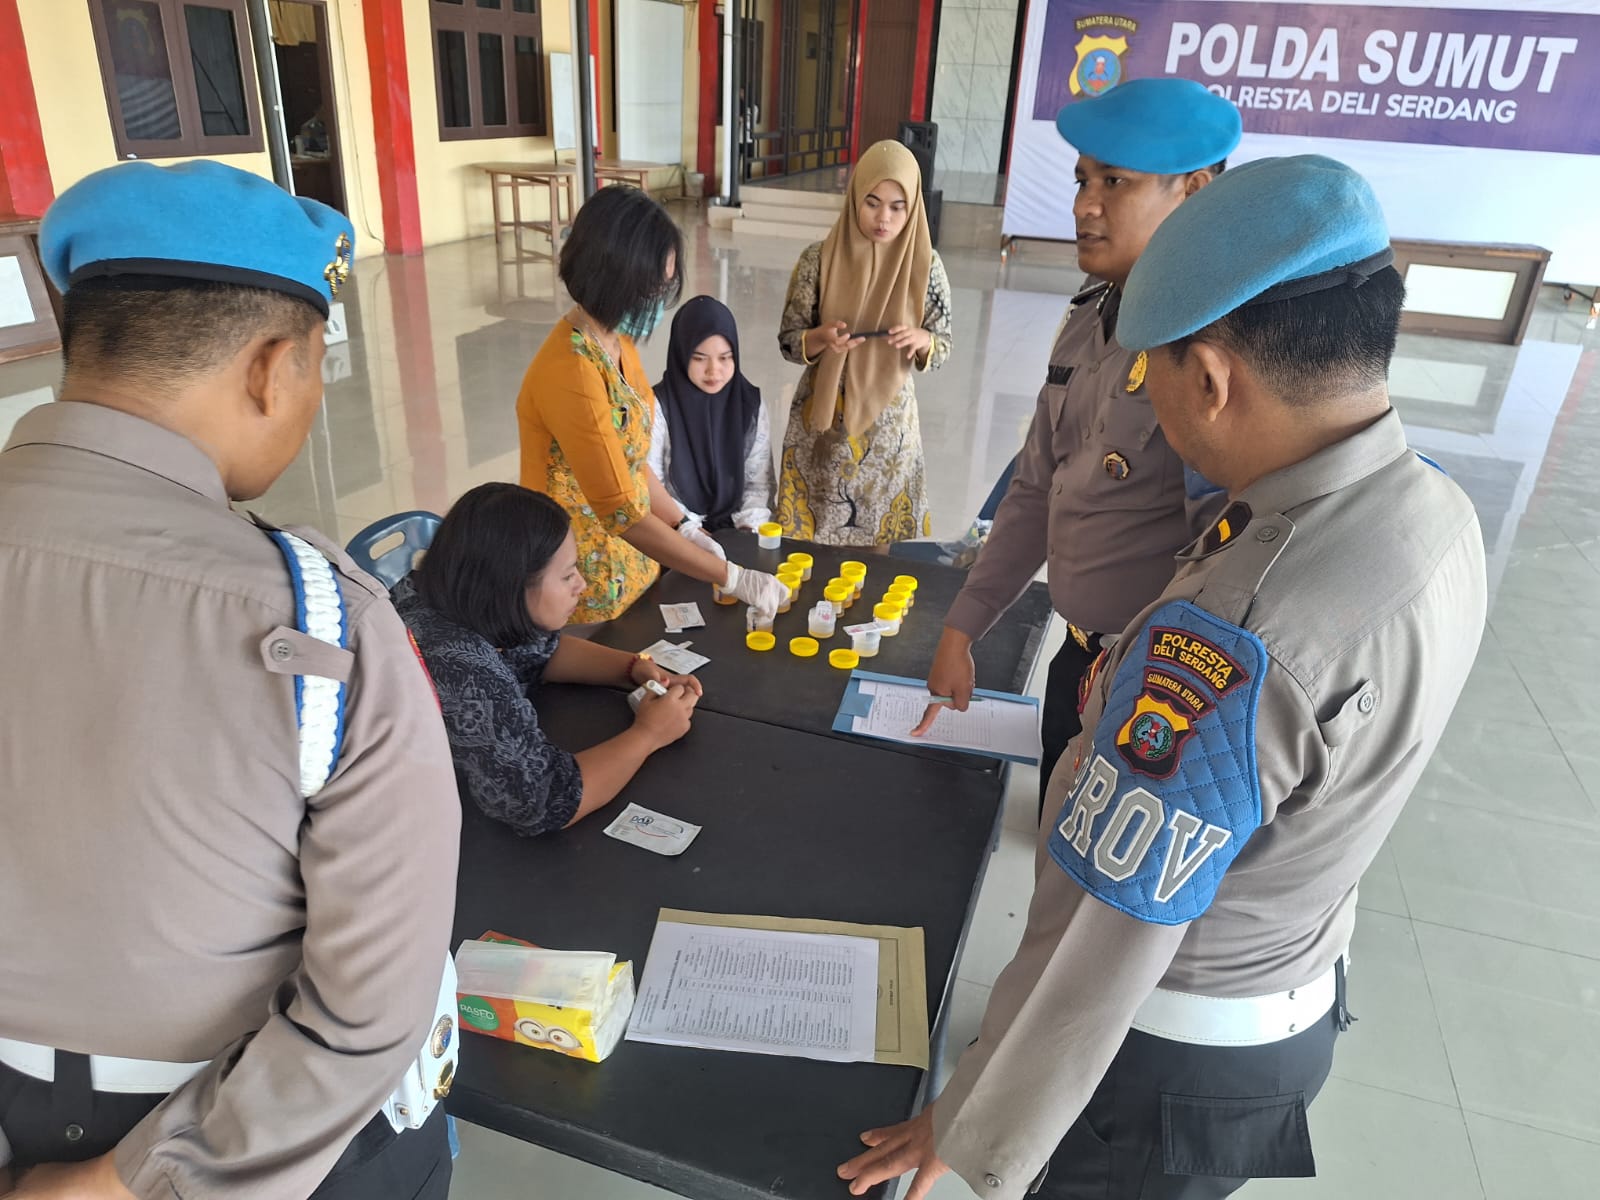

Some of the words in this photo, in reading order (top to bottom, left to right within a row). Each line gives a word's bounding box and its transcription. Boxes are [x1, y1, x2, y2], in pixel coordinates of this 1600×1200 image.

[1075, 15, 1114, 30] SUMATERA
[1114, 17, 1137, 32] UTARA
[1164, 21, 1340, 82] POLDA
[1358, 29, 1579, 93] SUMUT
[1207, 83, 1314, 112] OLRESTA
[1320, 90, 1381, 116] DELI
[1384, 93, 1518, 124] SERDANG
[1153, 644, 1176, 658] DELI
[1178, 651, 1227, 689] SERDANG
[1161, 633, 1233, 680] POLRESTA
[1147, 673, 1182, 694] SUMATERA
[1181, 688, 1205, 712] UTARA
